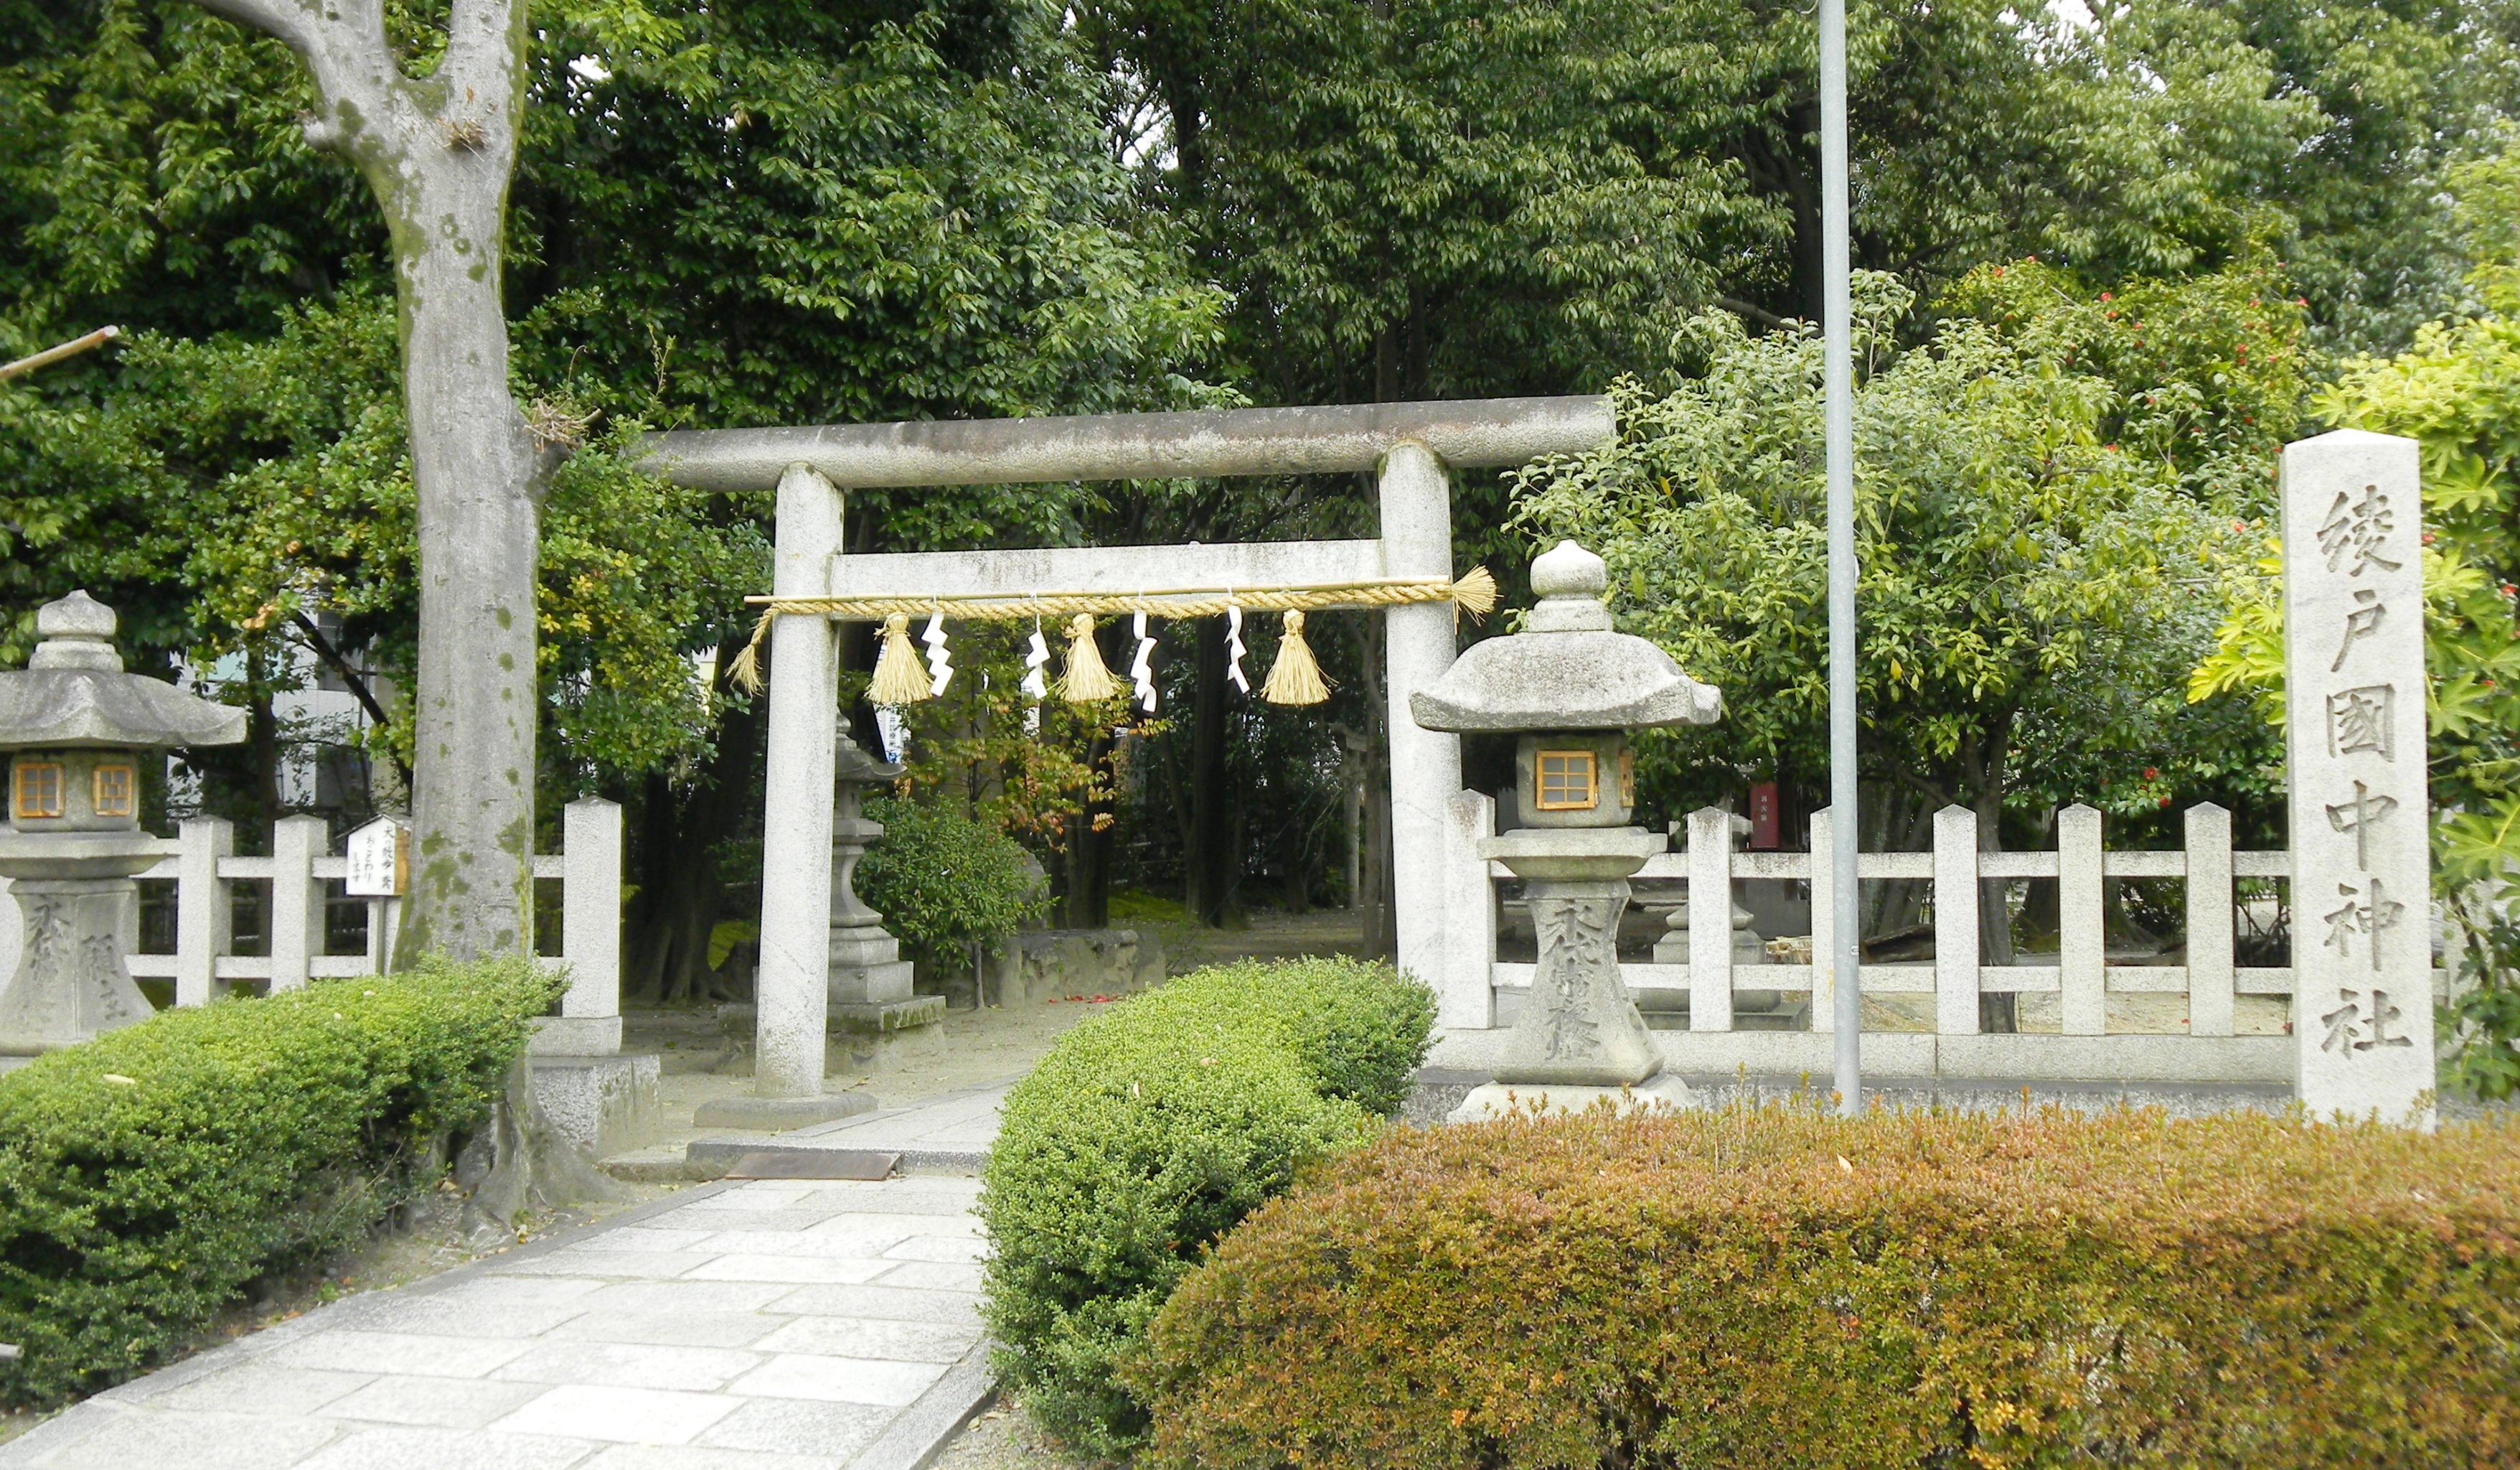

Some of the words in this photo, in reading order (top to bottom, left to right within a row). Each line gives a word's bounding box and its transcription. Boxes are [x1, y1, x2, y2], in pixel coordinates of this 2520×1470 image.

[2316, 484, 2413, 1060] 綾戸國中神社
[352, 852, 361, 883] します
[365, 835, 375, 883] おことわり
